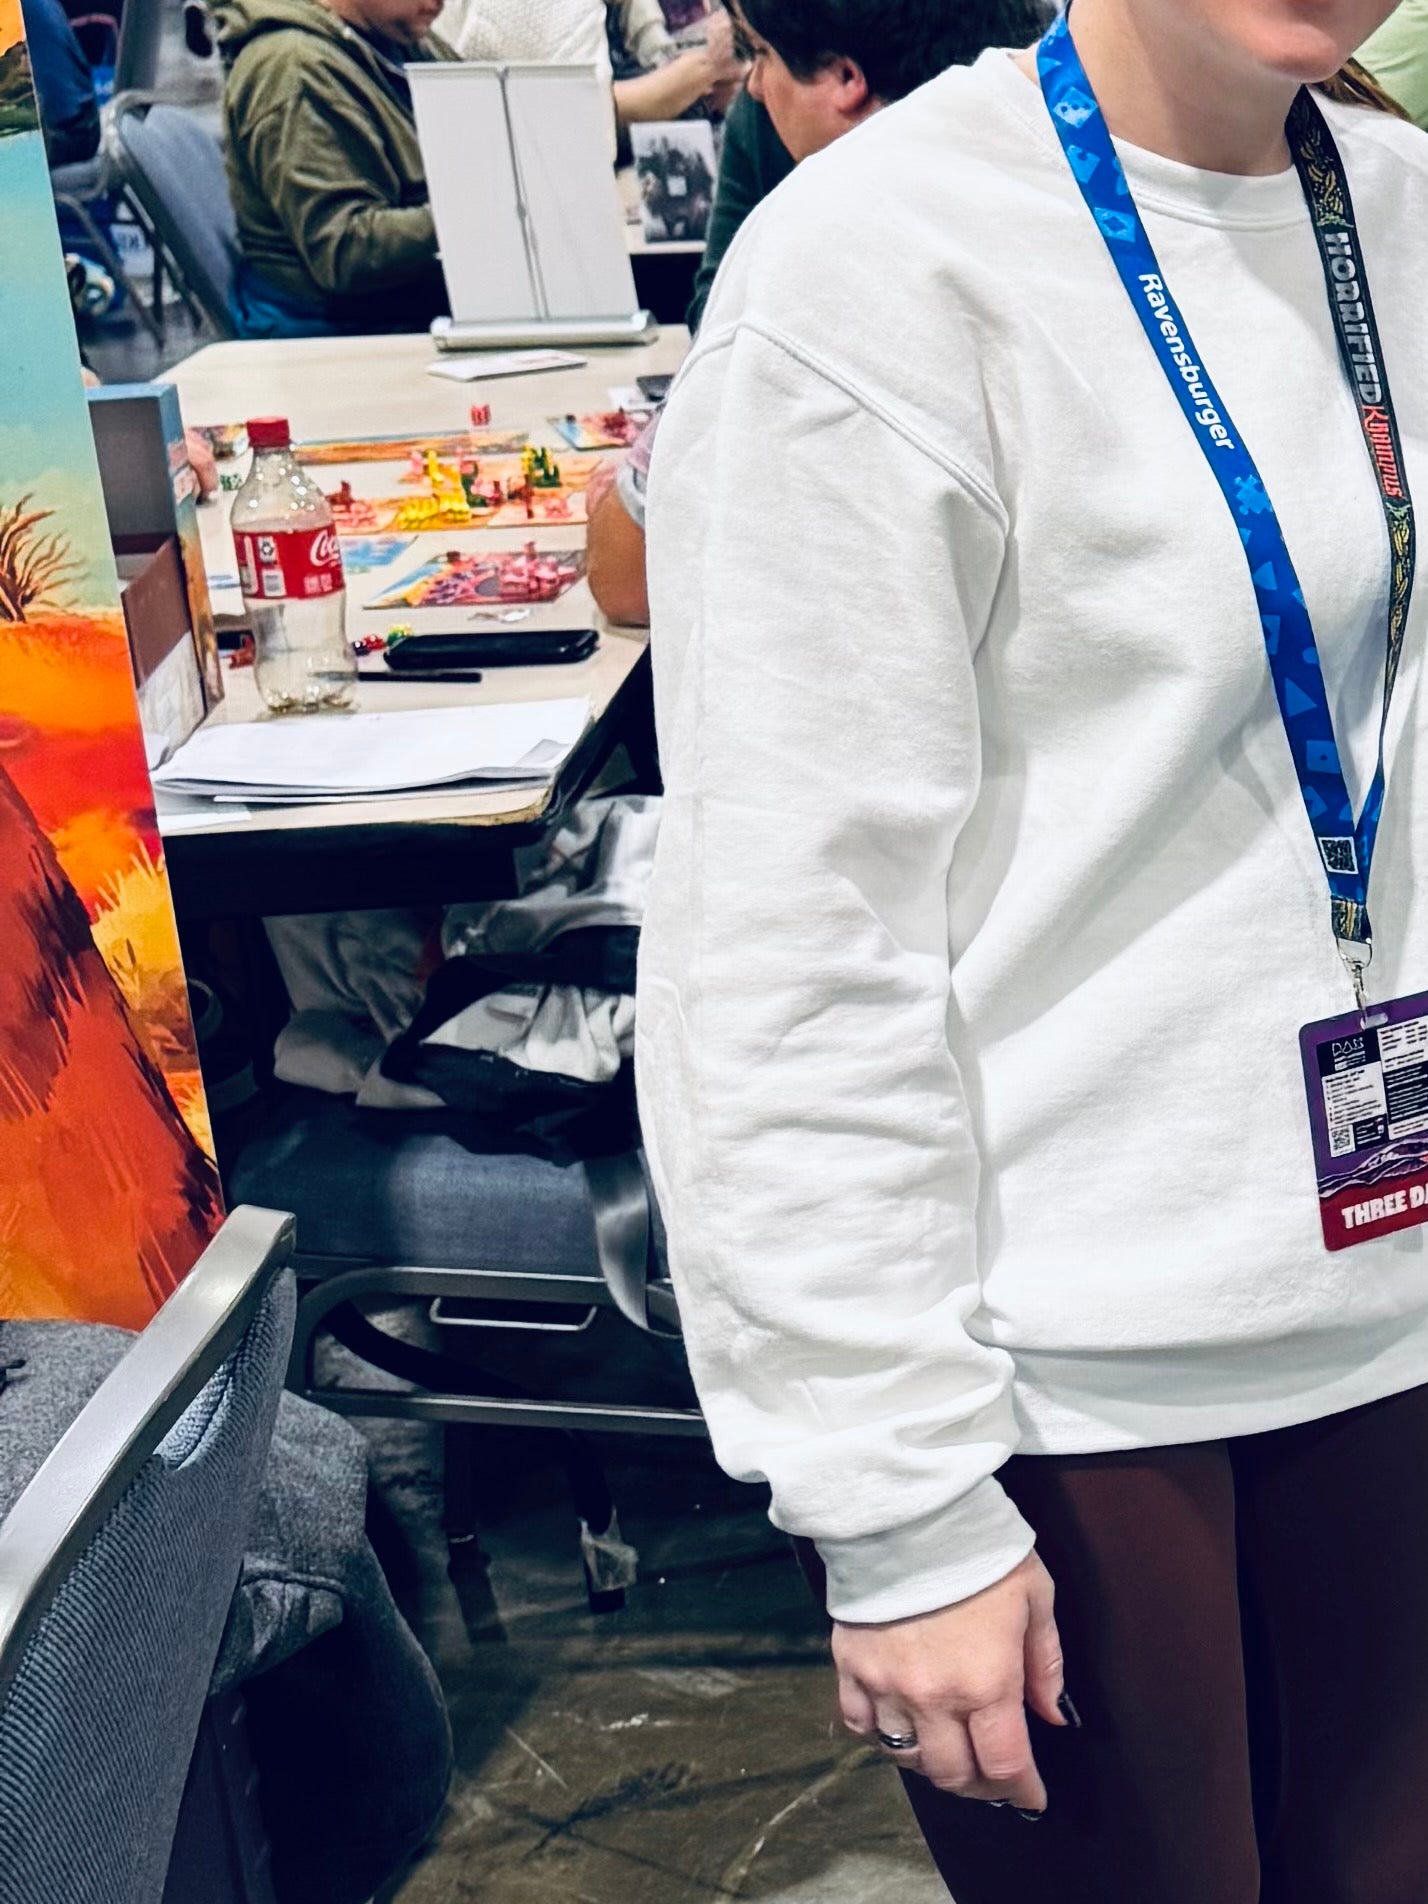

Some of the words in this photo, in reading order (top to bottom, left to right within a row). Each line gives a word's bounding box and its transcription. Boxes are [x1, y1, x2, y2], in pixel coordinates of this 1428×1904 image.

[1138, 273, 1235, 450] Ravensburger
[1325, 231, 1382, 404] HORRIFIED
[1341, 1189, 1408, 1230] THREE
